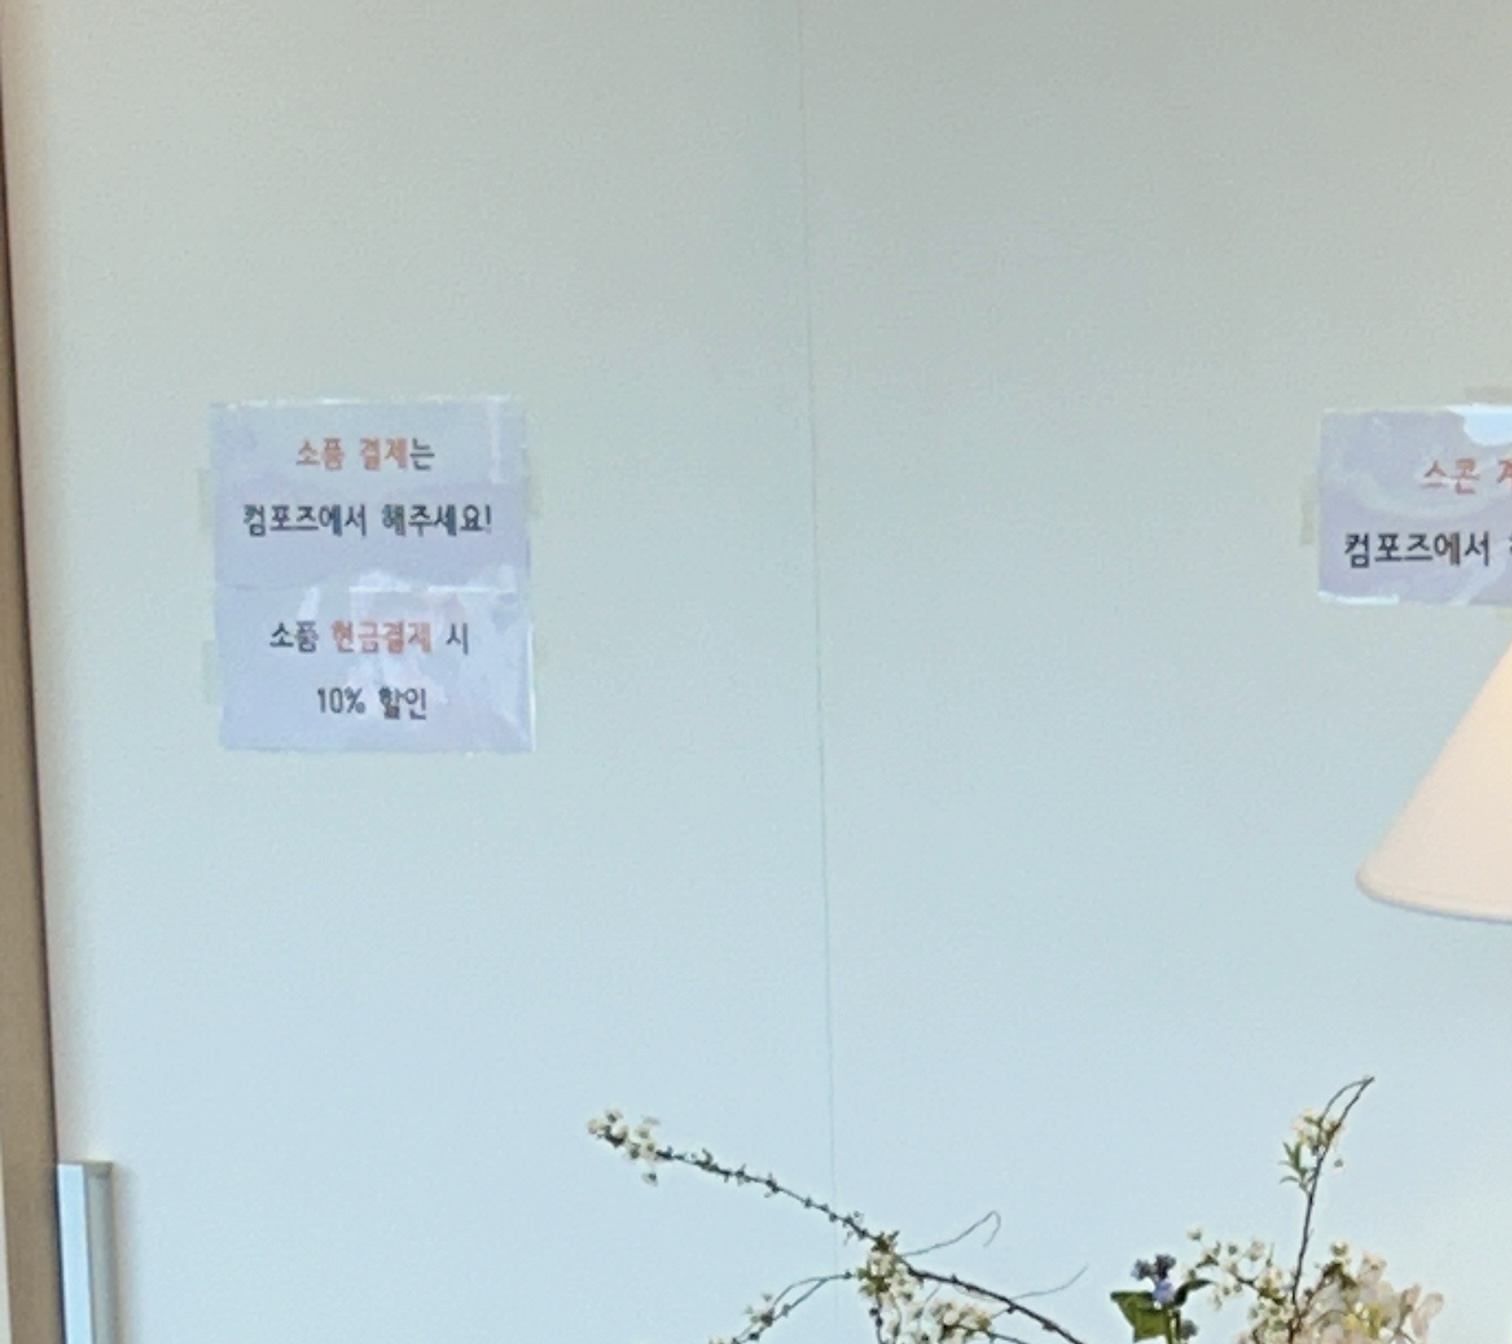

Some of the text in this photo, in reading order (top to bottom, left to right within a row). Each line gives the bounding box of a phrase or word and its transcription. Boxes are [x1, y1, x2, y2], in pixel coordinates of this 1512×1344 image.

[296, 437, 434, 471] 소품 결제는
[1420, 457, 1480, 494] 스콘
[243, 503, 492, 537] 컴포즈에서 해주세요!
[1344, 530, 1490, 569] 컴포즈에서
[269, 621, 470, 655] 소품 현금결제 시
[316, 686, 428, 721] 10% 할인
